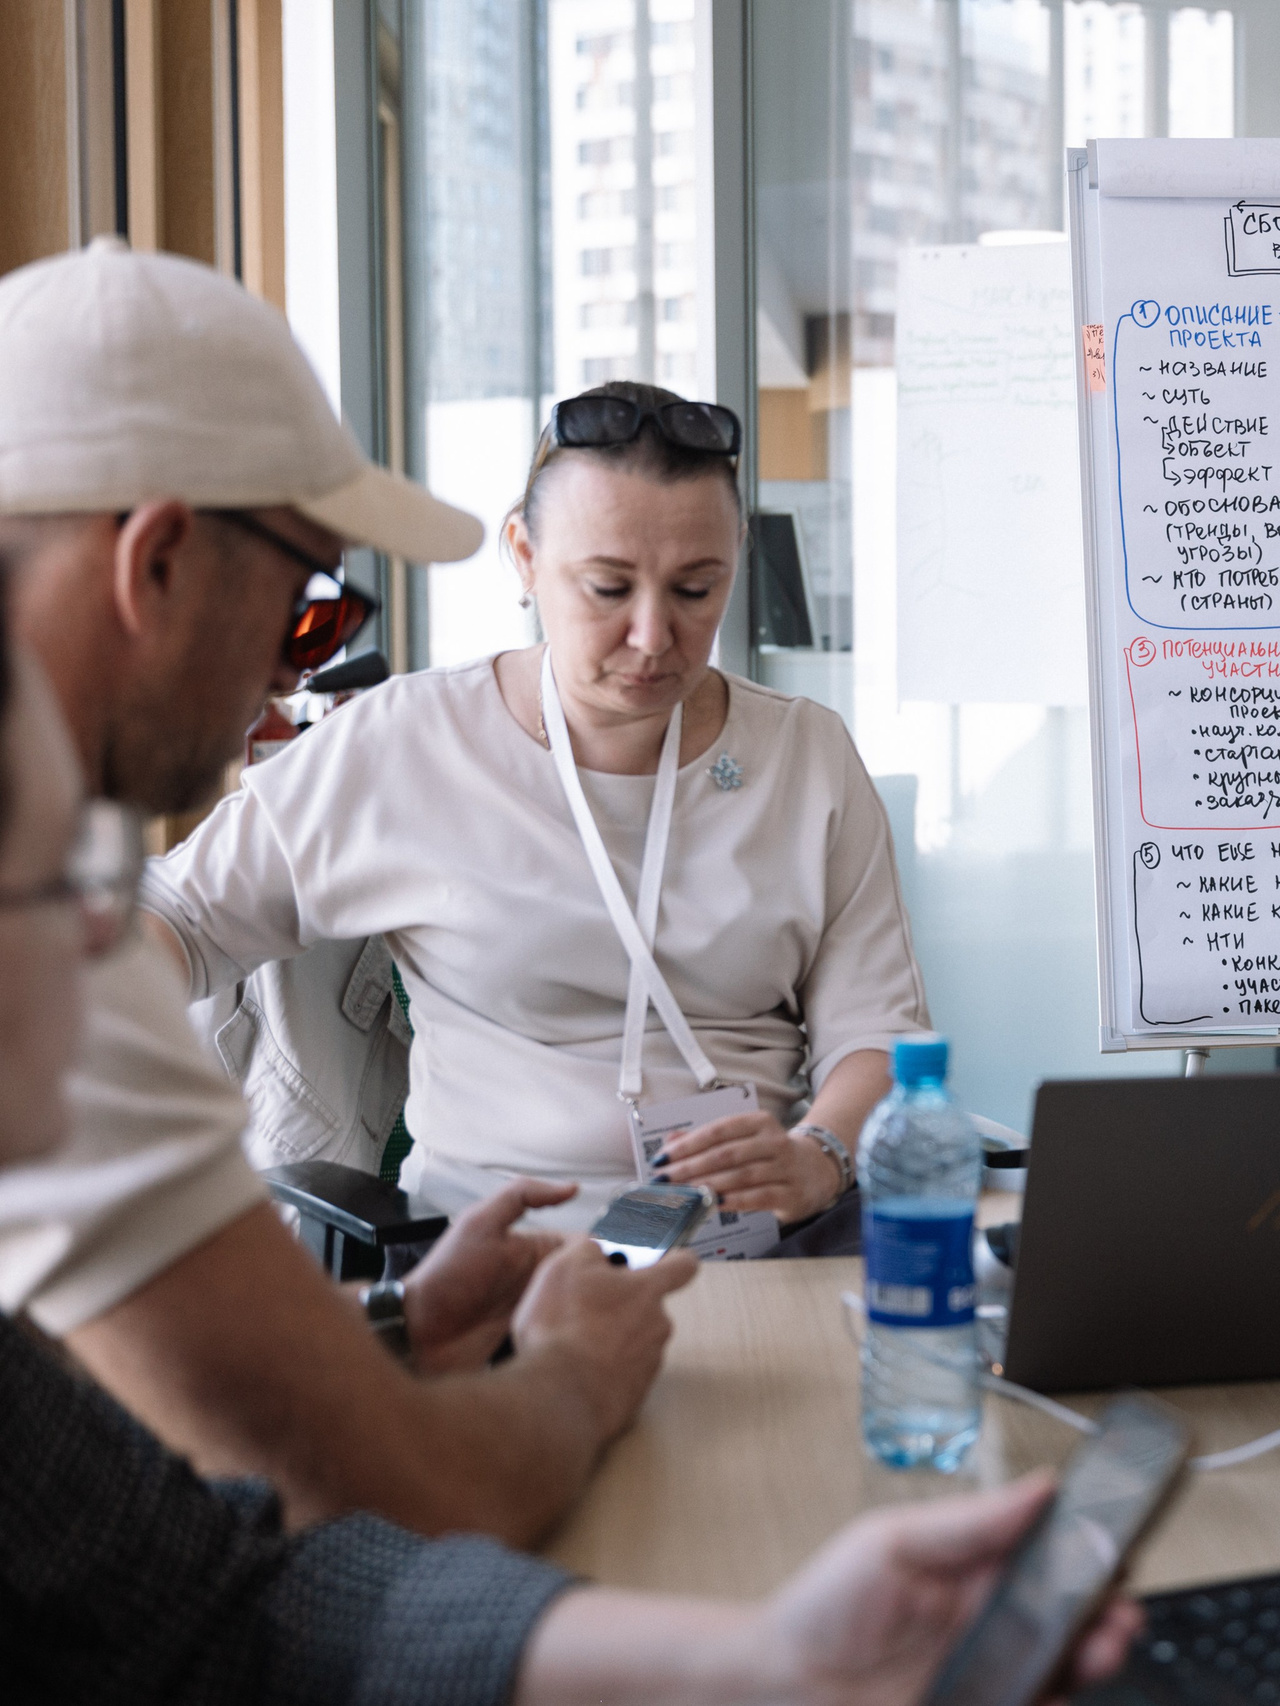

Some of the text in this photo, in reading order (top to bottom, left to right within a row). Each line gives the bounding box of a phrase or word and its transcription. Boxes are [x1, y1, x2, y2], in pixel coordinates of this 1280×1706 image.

[1165, 304, 1273, 327] ОПИСАНИЕ
[1169, 329, 1262, 350] ПРОЕКТА
[1166, 413, 1269, 440] ДЕЙСТВИЕ
[1173, 569, 1206, 589] КТО
[1180, 592, 1273, 612] (СТРАНЫ)
[1171, 844, 1205, 862] ЧТО
[1199, 875, 1259, 894] КАКИЕ
[1202, 902, 1260, 922] КАКИЕ
[1206, 932, 1246, 951] НТИ
